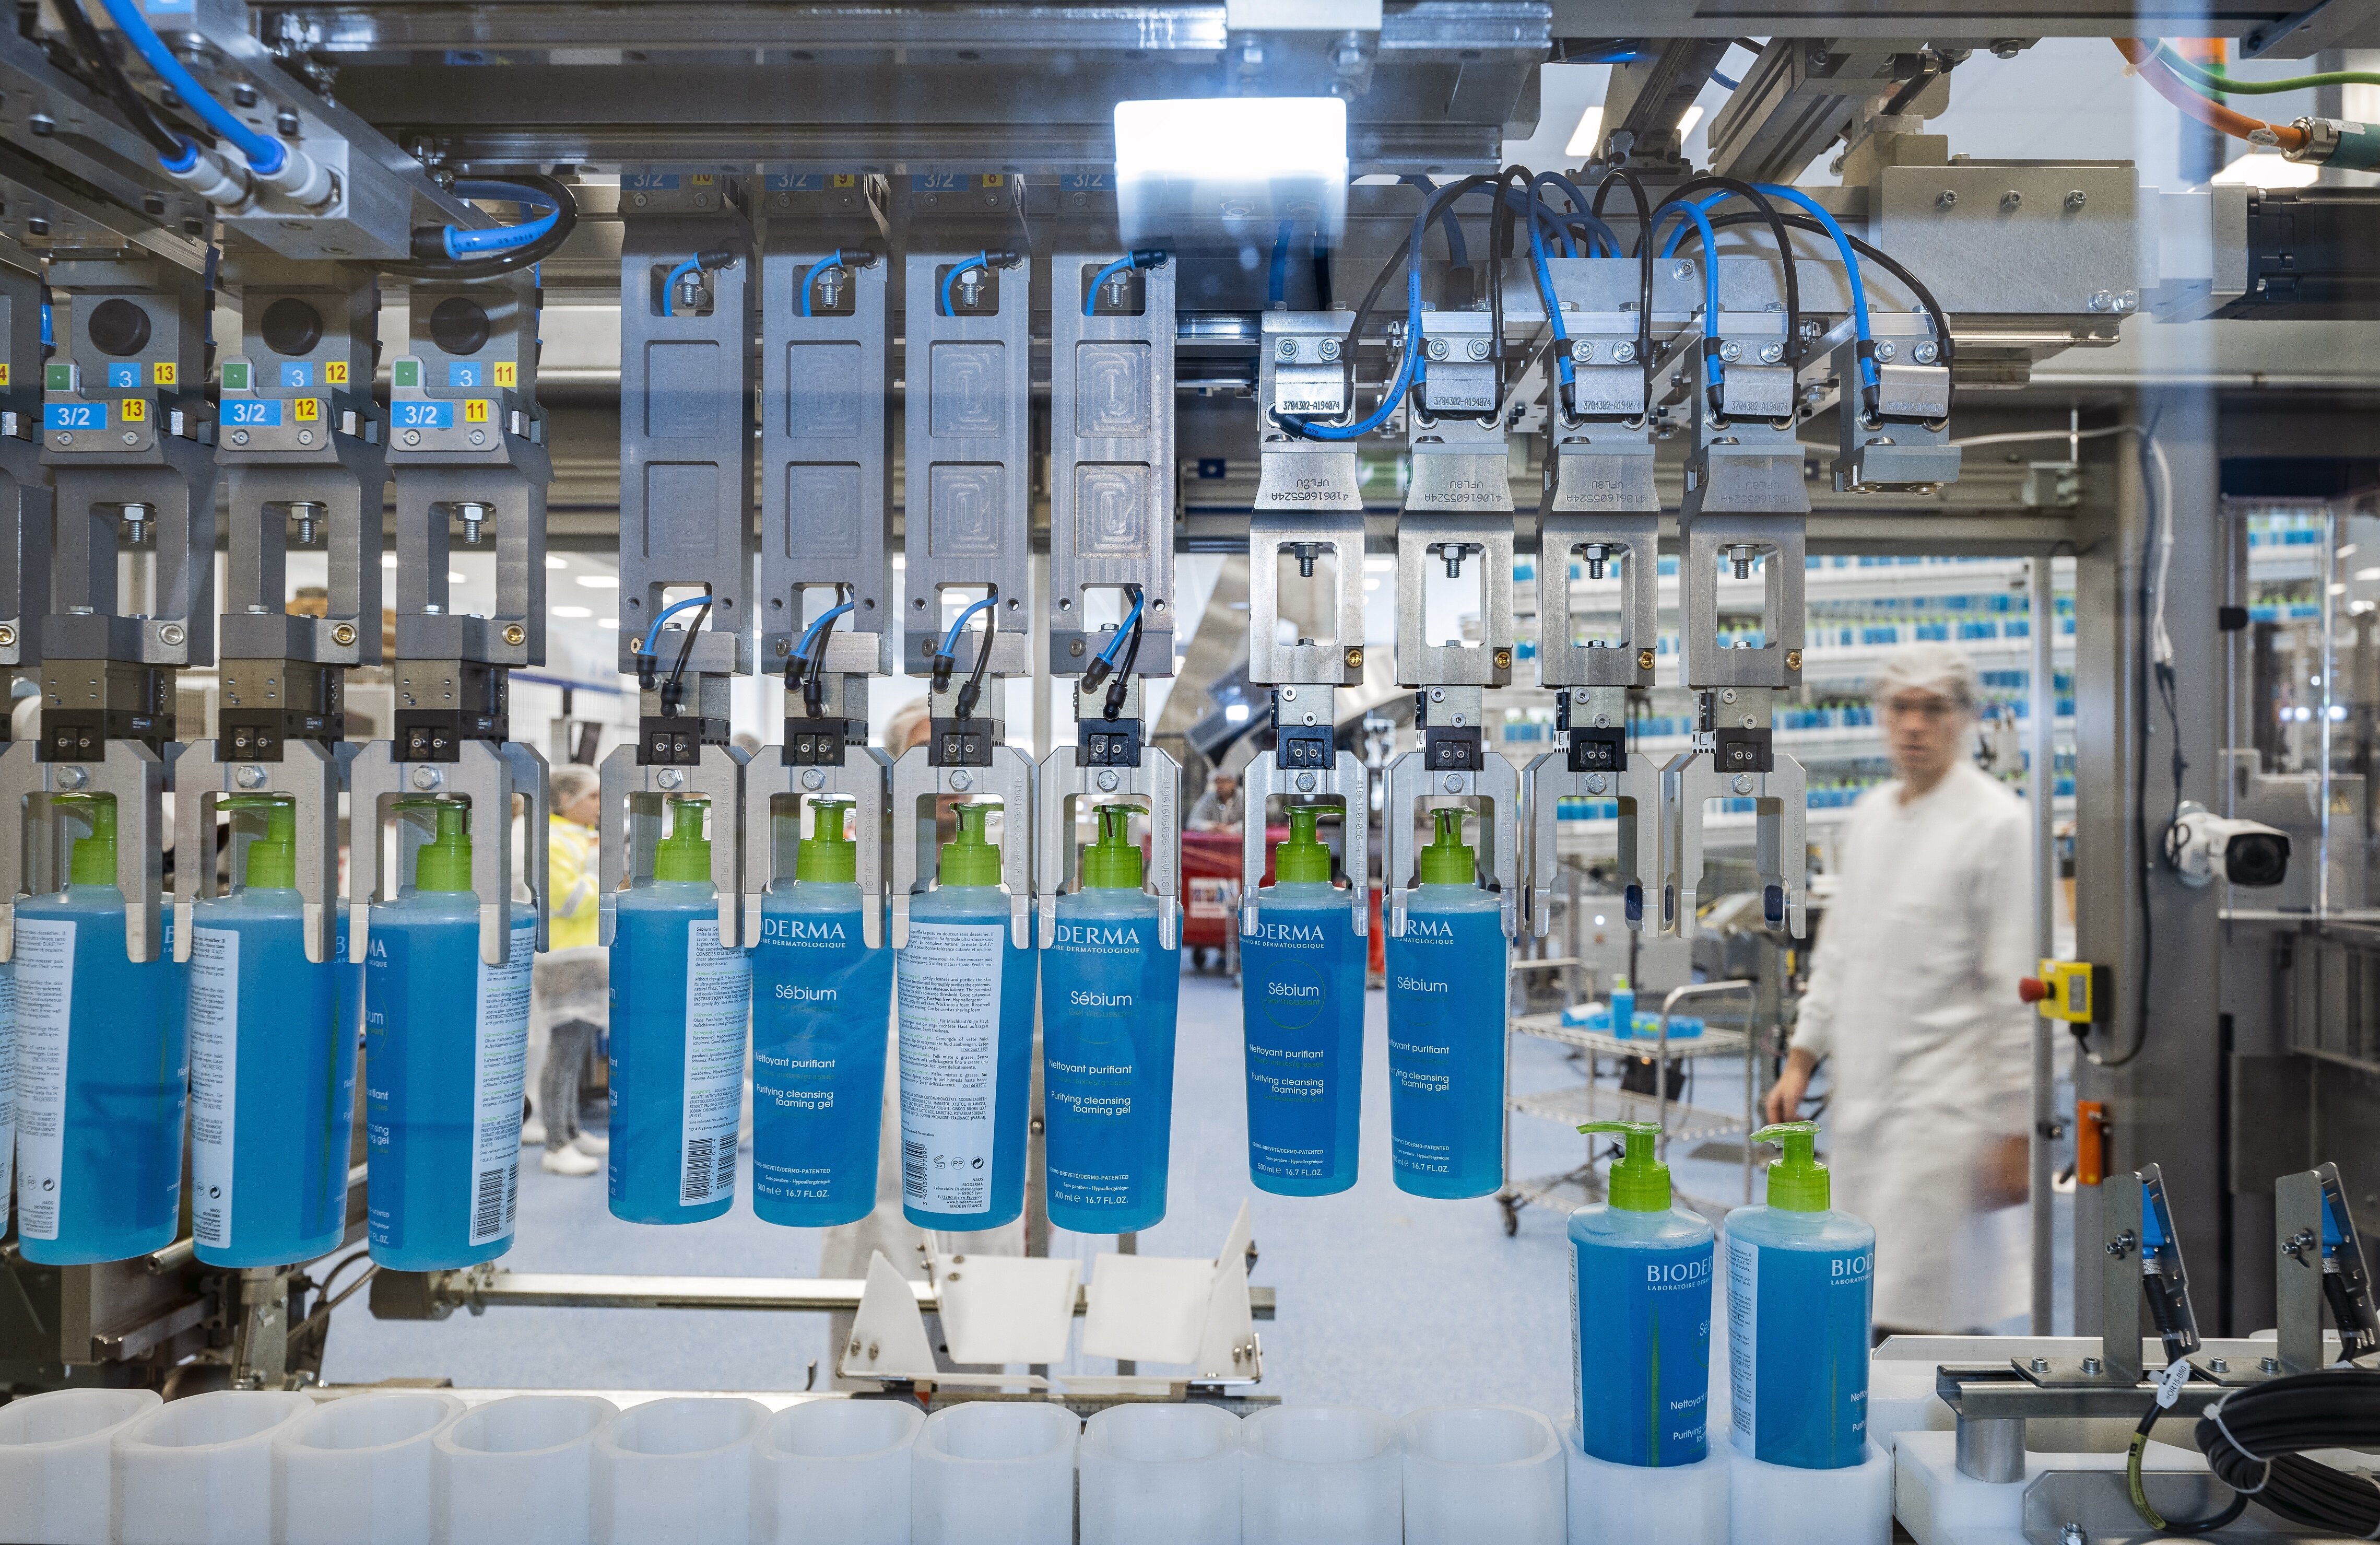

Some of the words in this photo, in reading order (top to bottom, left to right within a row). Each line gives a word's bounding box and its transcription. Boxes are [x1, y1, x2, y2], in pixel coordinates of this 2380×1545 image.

[119, 371, 133, 387] 3
[157, 365, 174, 381] 13
[291, 370, 304, 387] 3
[328, 365, 346, 380] 12
[460, 370, 473, 387] 3
[497, 366, 513, 381] 11
[124, 400, 143, 417] 13
[297, 400, 315, 417] 12
[1283, 401, 1340, 411] 3704302-A194074
[1433, 396, 1491, 406] 3704302-A194074
[57, 407, 90, 426] 3/2
[233, 404, 266, 422] 3/2
[405, 405, 437, 424] 3/2
[468, 403, 484, 419] 11
[1450, 481, 1483, 489] VFL8U
[761, 918, 846, 939] DERMA
[1057, 925, 1140, 944] DERMA
[1238, 918, 1325, 940] BDERMA
[772, 940, 846, 949] DERMATOLOGIQUE
[1268, 982, 1319, 997] Sébium
[1397, 976, 1447, 992] Sébium
[775, 984, 837, 1000] Sébium
[1071, 991, 1132, 1006] Sébium
[1250, 1044, 1283, 1057] Nettoyant
[1286, 1050, 1324, 1059] purifiant
[1389, 1039, 1410, 1051] ettoyant
[1412, 1045, 1450, 1054] purifiant
[755, 1052, 789, 1066] Nettoyant
[792, 1059, 835, 1069] purifiant
[1049, 1059, 1086, 1073] Nettoyant
[1089, 1065, 1132, 1075] purifiant
[1252, 1072, 1279, 1085] Purifying
[1281, 1078, 1324, 1087] cleansing
[1401, 1079, 1433, 1091] foaming
[1409, 1072, 1449, 1083] cleansing
[757, 1083, 784, 1098] Purifying
[786, 1090, 834, 1100] cleansing
[1272, 1085, 1307, 1096] foaming
[1310, 1087, 1324, 1096] gel
[776, 1097, 815, 1109] foaming
[817, 1099, 833, 1109] gel
[1051, 1091, 1081, 1104] Purifying
[1084, 1096, 1131, 1106] cleansing
[1073, 1105, 1113, 1116] foaming
[1115, 1106, 1130, 1116] gel
[377, 1137, 389, 1145] gel
[1258, 1163, 1266, 1172] 500
[766, 1186, 774, 1195] ml
[786, 1189, 802, 1198] 16.7
[1054, 1190, 1063, 1200] 500
[1647, 1255, 1713, 1282] BIODER
[1832, 1253, 1874, 1276] BIOD
[1831, 1272, 1870, 1285] LABORATOIRE
[1647, 1282, 1695, 1291] LABORATOIRE
[1671, 1392, 1705, 1410] Nettoyant
[1673, 1426, 1702, 1440] Purifying
